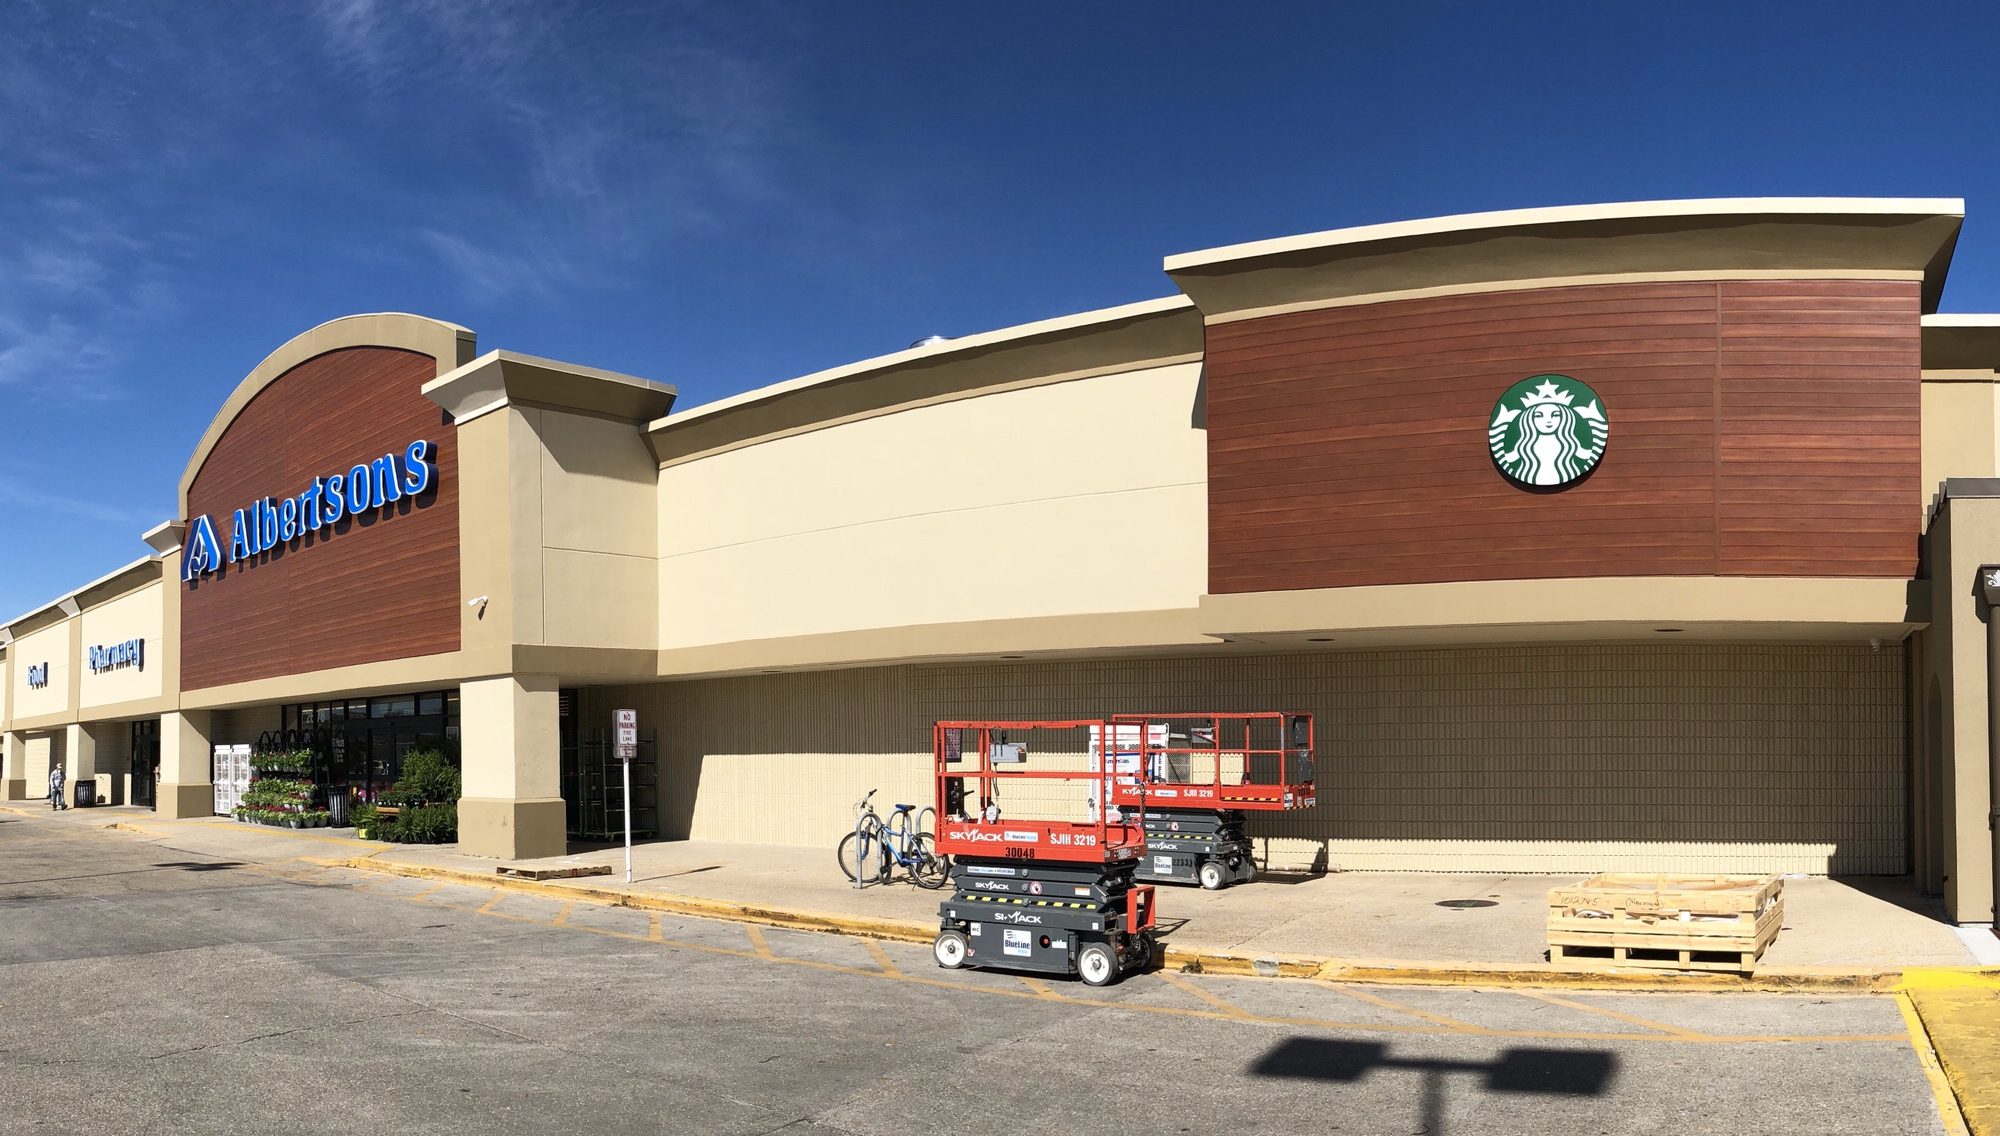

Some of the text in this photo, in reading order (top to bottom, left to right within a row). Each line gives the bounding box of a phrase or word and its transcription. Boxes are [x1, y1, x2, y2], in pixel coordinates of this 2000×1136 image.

[229, 439, 434, 563] Albertsons
[89, 639, 142, 669] Pharmacy
[28, 662, 46, 686] Food
[623, 712, 631, 721] NO
[1198, 789, 1214, 798] 3219
[950, 828, 1003, 842] SKYJACK
[1073, 834, 1096, 847] 3219
[1147, 842, 1178, 850] SKYJACK
[1005, 847, 1035, 859] 30048
[975, 880, 1010, 890] SKYJACK
[1005, 940, 1031, 949] BlueLine
